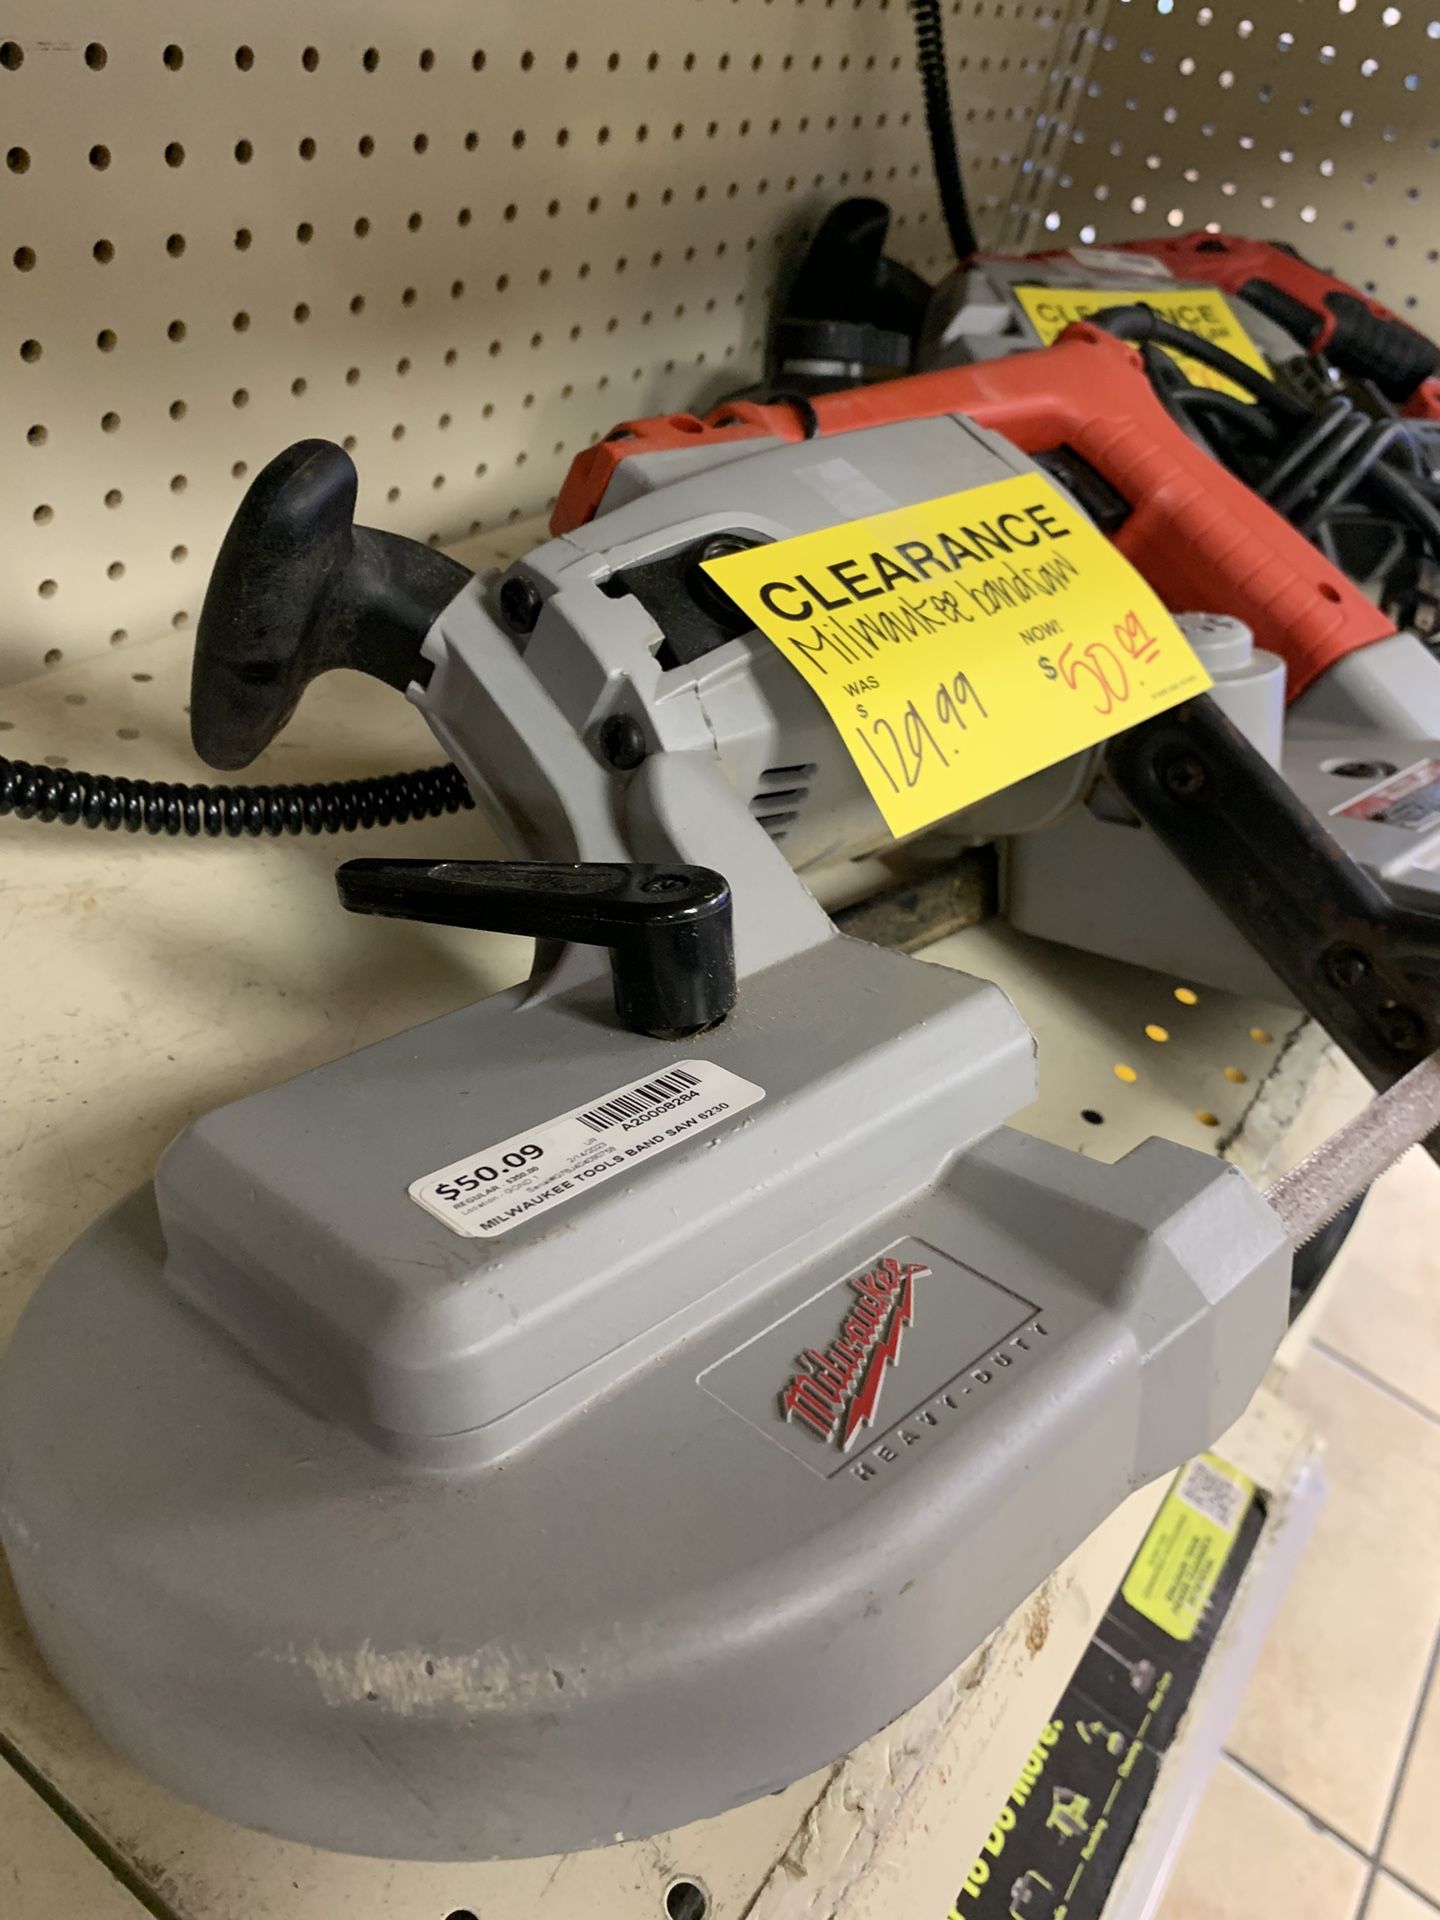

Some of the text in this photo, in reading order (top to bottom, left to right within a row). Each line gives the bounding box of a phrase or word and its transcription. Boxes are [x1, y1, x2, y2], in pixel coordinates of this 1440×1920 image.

[759, 504, 1071, 621] CLEARANCE
[1018, 619, 1064, 646] NOW!
[843, 675, 880, 697] WAS
[621, 1090, 701, 1132] A20008284
[435, 1144, 544, 1201] $50.09
[480, 1180, 575, 1231] MILWAUKEE
[574, 1155, 625, 1182] TOOLS
[624, 1135, 665, 1157] BAND
[665, 1117, 698, 1137] SAW
[698, 1102, 730, 1120] 6230
[453, 1185, 500, 1209] REGULAR
[778, 1257, 902, 1444] Milwaukee
[850, 1322, 1048, 1481] HEAVY-DUTY
